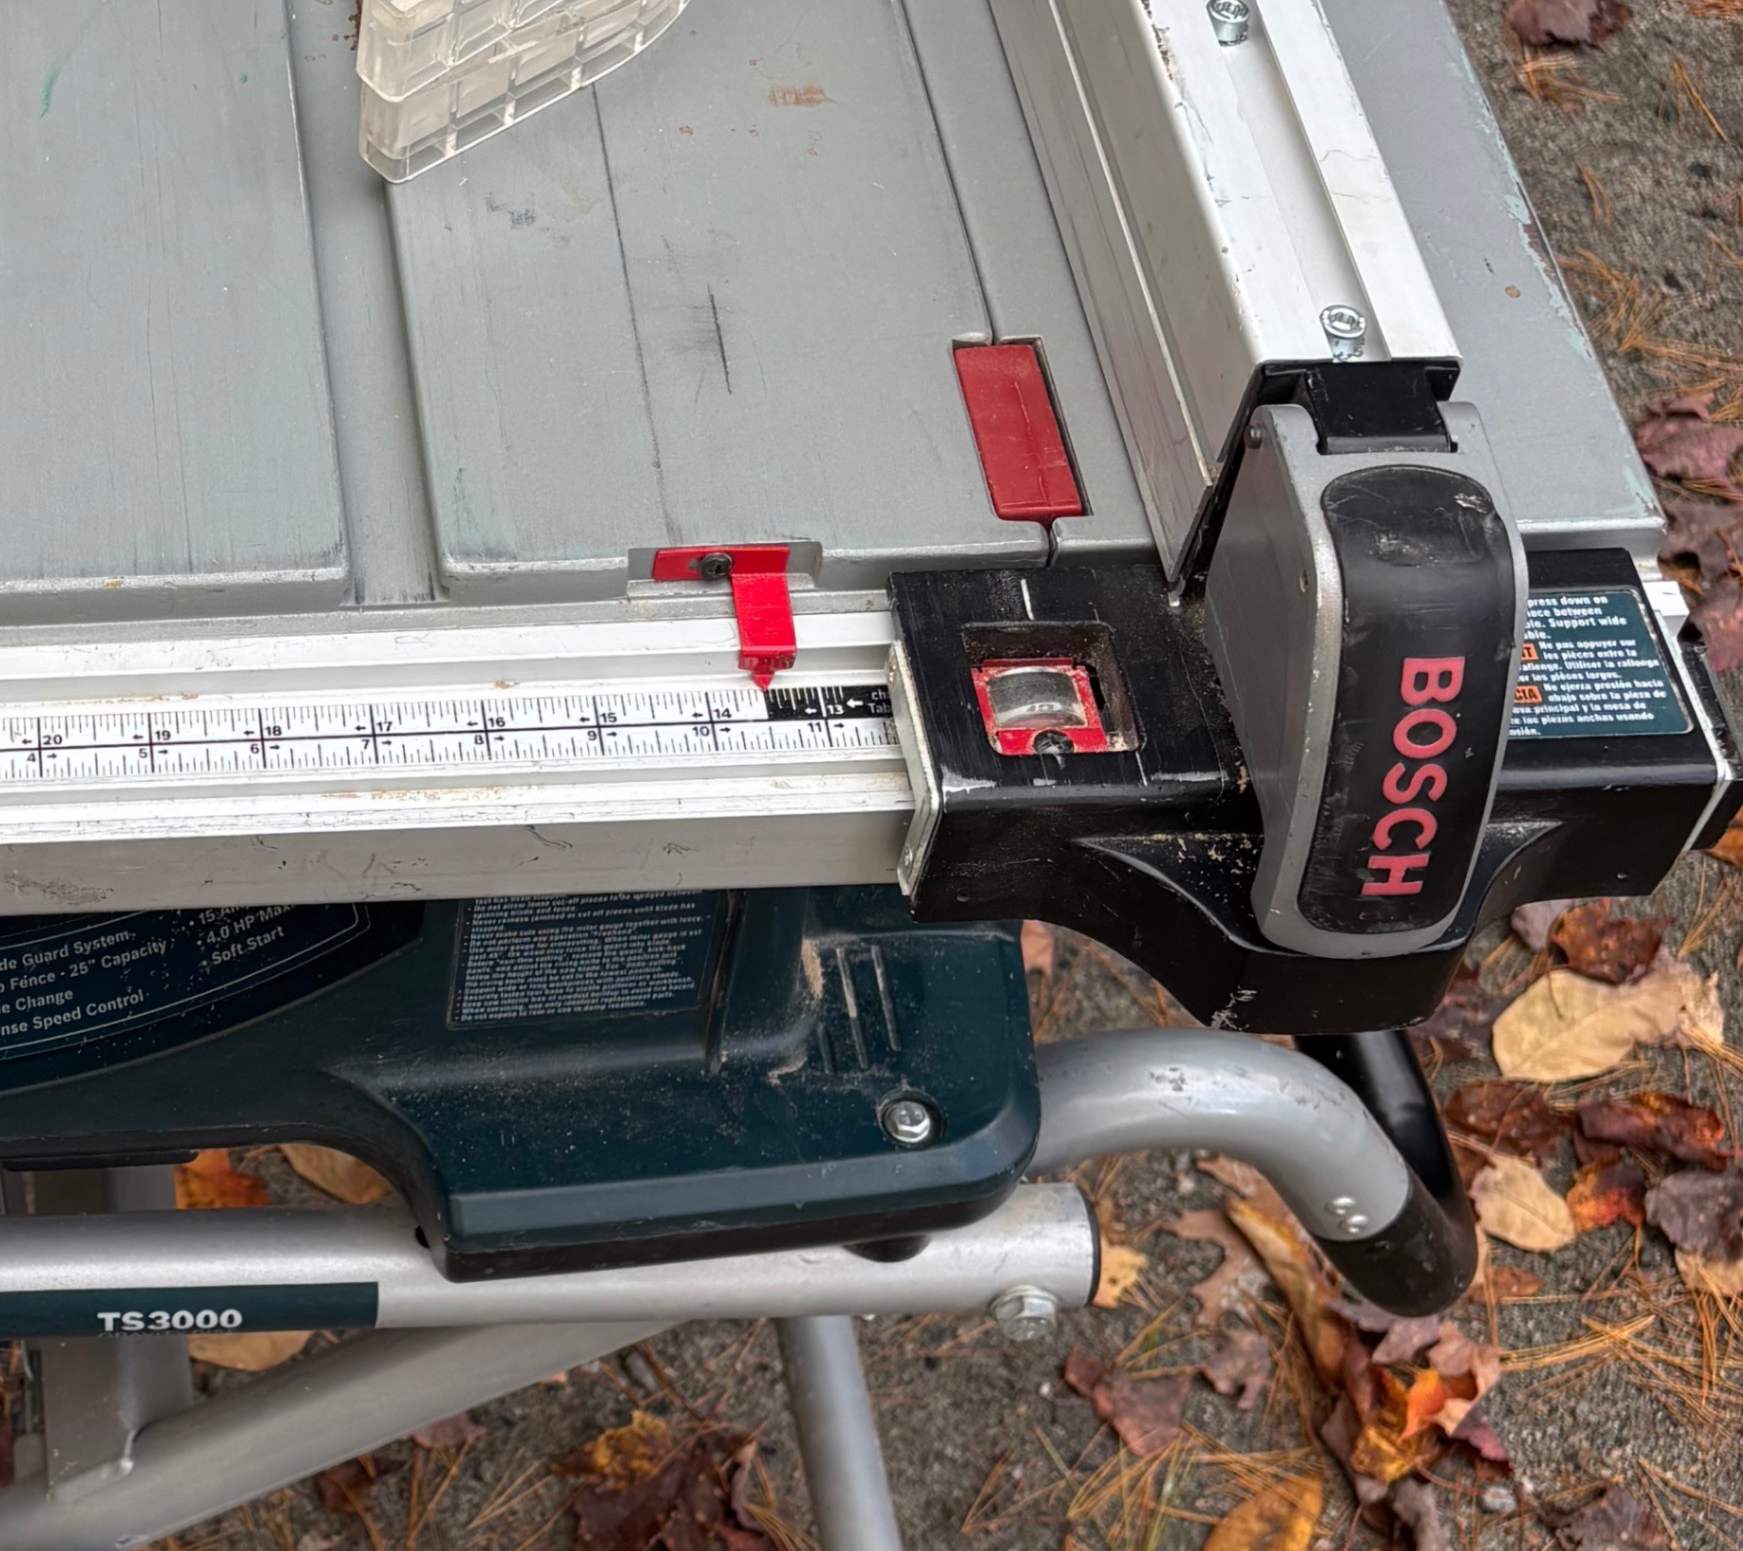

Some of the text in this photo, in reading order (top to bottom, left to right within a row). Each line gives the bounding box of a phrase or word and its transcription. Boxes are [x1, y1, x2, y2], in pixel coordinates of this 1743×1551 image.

[1527, 595, 1609, 607] press down on
[1554, 607, 1602, 616] between
[1548, 615, 1627, 628] Support wide
[871, 689, 891, 701] ch
[42, 734, 62, 745] 20
[156, 729, 171, 741] 19
[266, 725, 282, 737] 18
[378, 720, 394, 732] 17
[489, 716, 505, 728] 16
[601, 712, 617, 724] 15
[714, 708, 731, 719] 14
[827, 704, 845, 716] 13
[26, 752, 36, 763] 4
[139, 748, 148, 759] 5
[250, 743, 259, 754] 6
[362, 738, 370, 750] 7
[473, 734, 484, 745] 8
[587, 730, 597, 741] 9
[692, 725, 710, 737] 10
[807, 721, 822, 733] 11
[1361, 656, 1465, 896] BOSCH
[199, 910, 215, 925] 15
[207, 925, 230, 943] 4.0
[234, 914, 255, 933] HP
[22, 943, 69, 968] Guard
[211, 925, 285, 965] Soft Start
[9, 972, 56, 991] Fence
[68, 958, 96, 978] 25"
[100, 940, 167, 969] Capacity
[15, 990, 74, 1011] Change
[32, 1006, 82, 1031] Speed
[85, 988, 145, 1017] Control
[97, 1308, 243, 1332] TS3000
